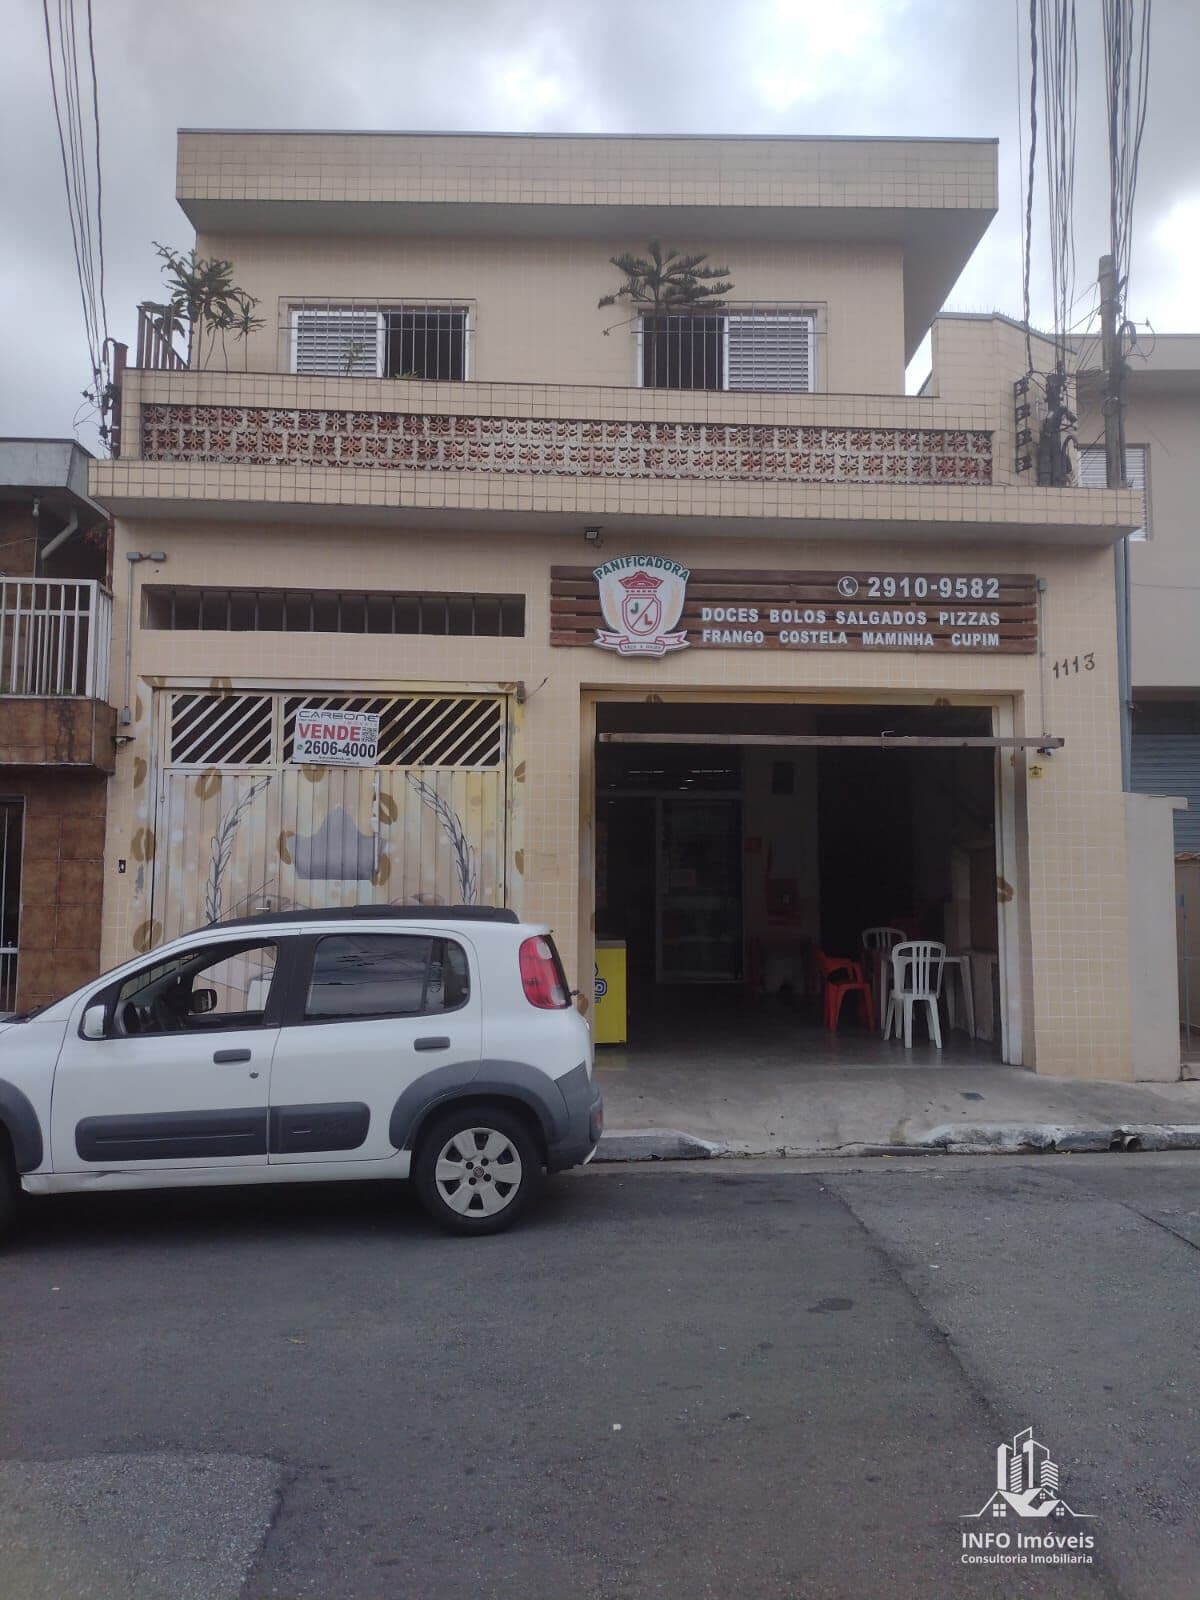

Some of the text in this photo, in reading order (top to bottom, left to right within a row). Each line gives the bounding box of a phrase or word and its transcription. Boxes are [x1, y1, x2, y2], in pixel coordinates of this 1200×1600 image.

[594, 556, 690, 581] PANIFICADORA
[867, 576, 1000, 599] 2910-9582
[630, 601, 639, 614] J
[702, 607, 1000, 626] DOCES BOLOS SALGADOS PIZZAS
[644, 613, 652, 626] L
[702, 629, 999, 647] FRANGO COSTELA MAMINHA CUPIM
[1052, 652, 1096, 679] 1113
[299, 723, 362, 742] VENDE
[304, 740, 376, 758] 2606-4000
